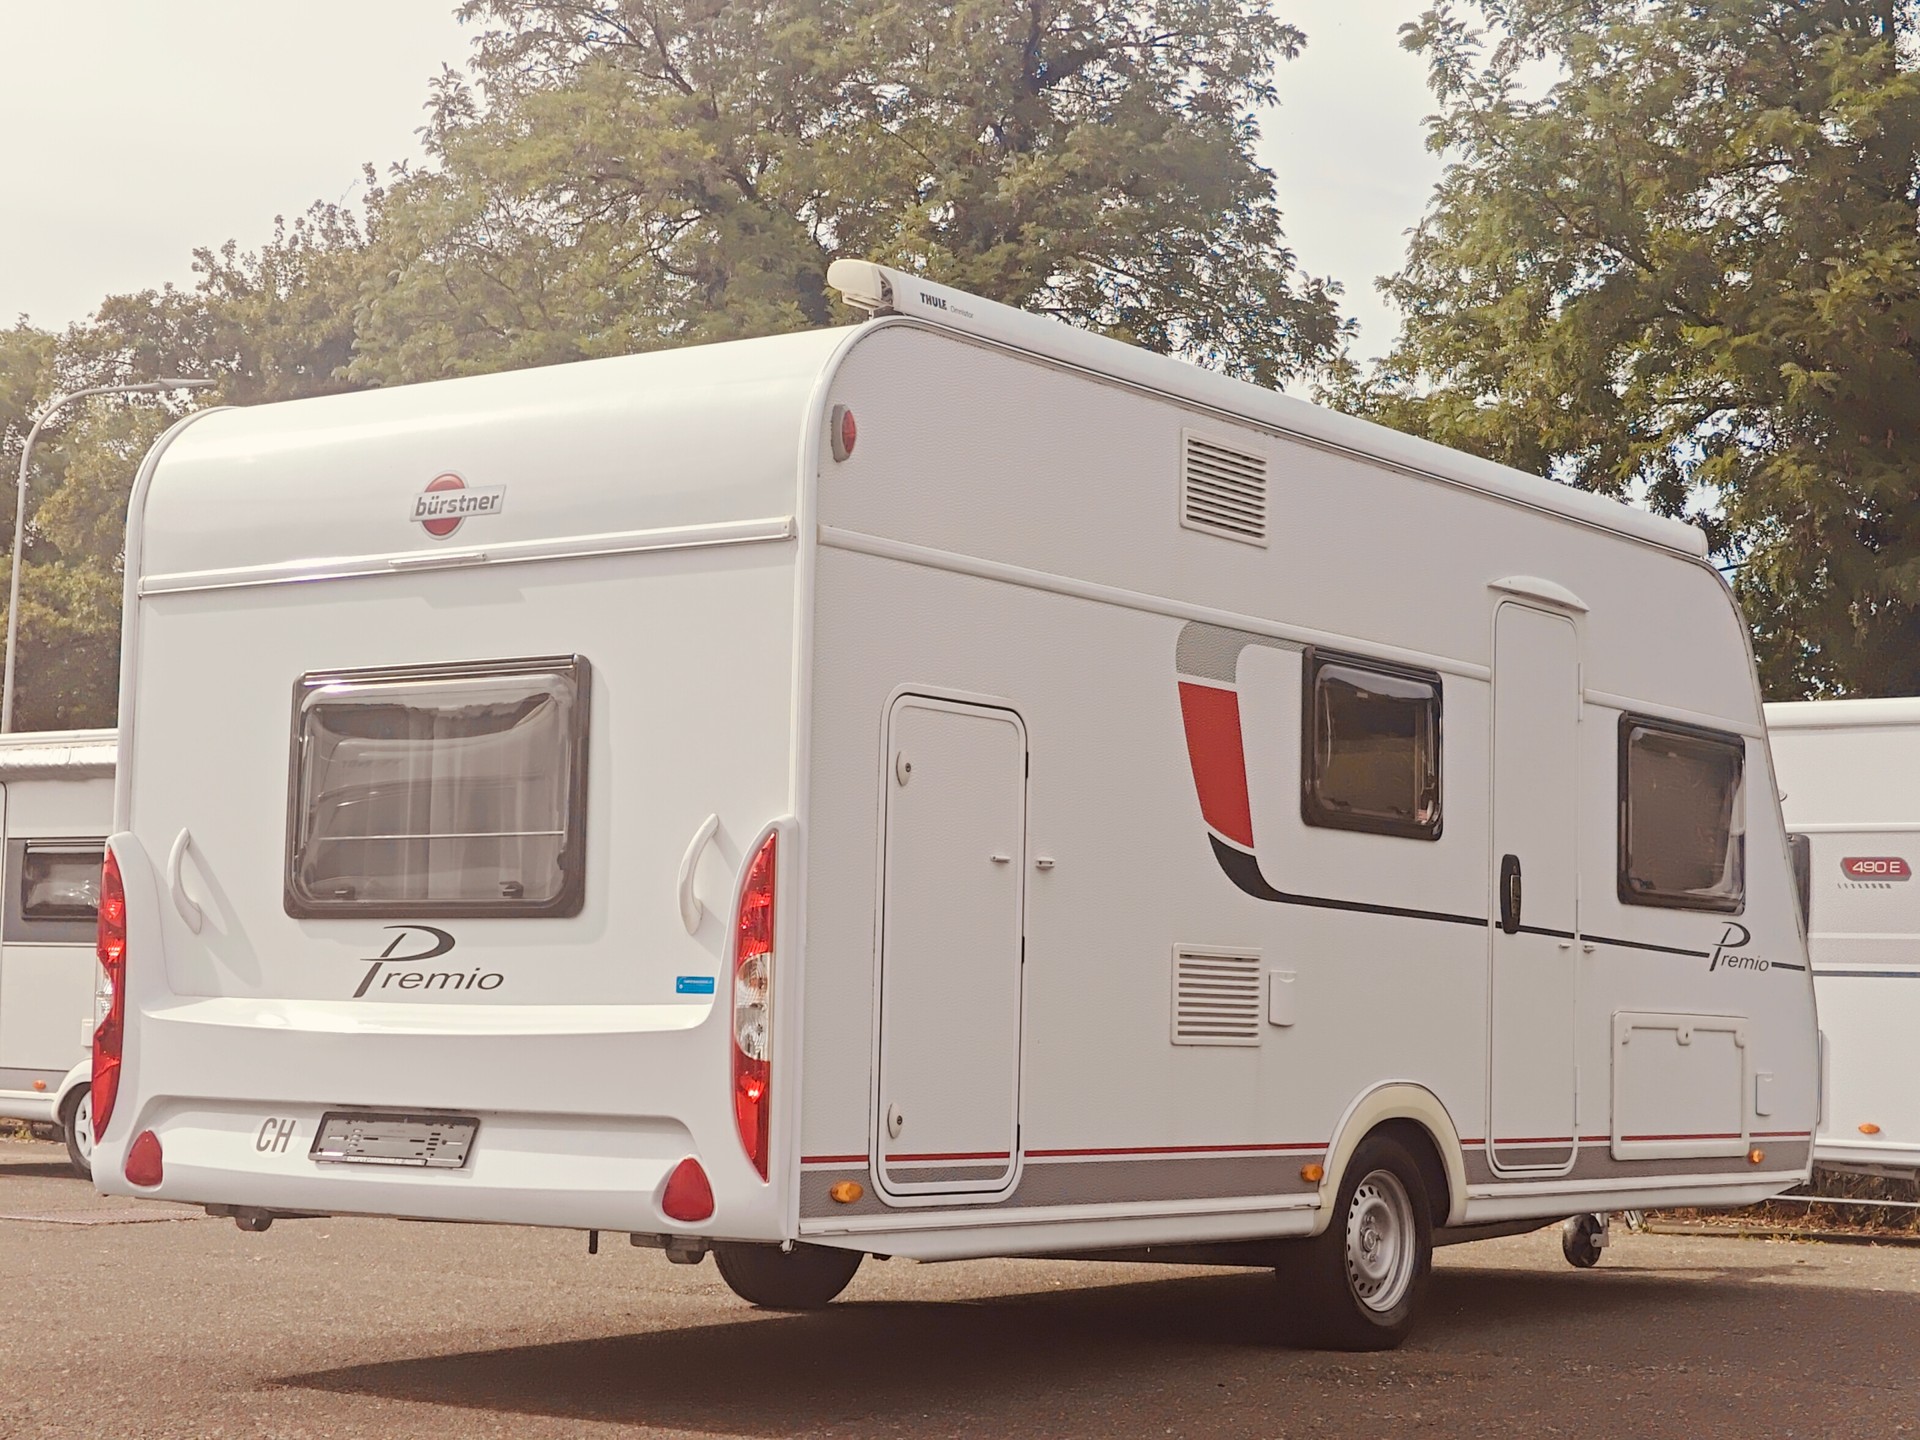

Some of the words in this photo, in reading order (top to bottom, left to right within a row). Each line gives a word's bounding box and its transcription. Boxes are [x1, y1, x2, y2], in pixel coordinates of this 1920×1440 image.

[920, 292, 947, 311] THULE
[414, 494, 499, 517] bürstner
[1852, 861, 1887, 873] 490
[1889, 861, 1901, 873] E
[1709, 921, 1769, 972] Premio
[352, 925, 504, 998] Premio
[256, 1117, 296, 1153] CH
